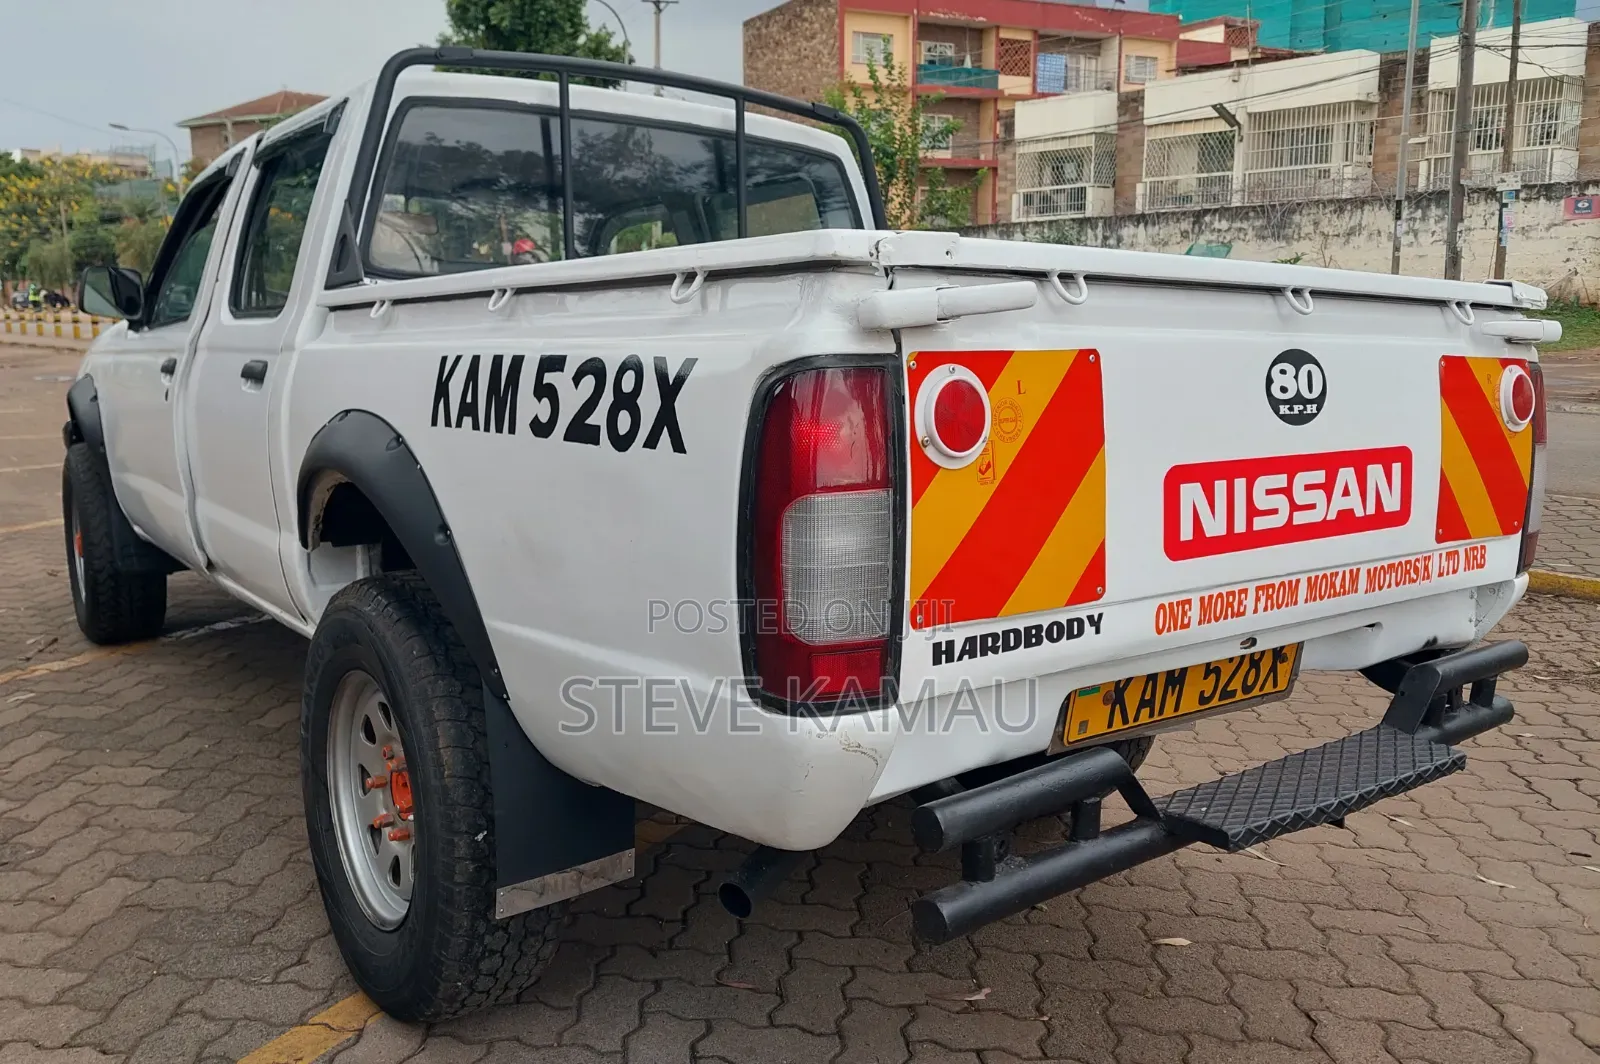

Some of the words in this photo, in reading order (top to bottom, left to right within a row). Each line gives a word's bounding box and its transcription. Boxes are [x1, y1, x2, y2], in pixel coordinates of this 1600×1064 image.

[431, 354, 526, 435] KAM
[529, 354, 699, 455] 528X
[1017, 379, 1026, 394] L
[1271, 362, 1324, 400] 80
[1278, 403, 1318, 415] K.P.H
[1179, 461, 1402, 543] NISSAN
[1154, 597, 1192, 636] ONE
[1197, 587, 1249, 626] MORE
[1252, 577, 1301, 615] FROM
[1304, 566, 1361, 604] MOKAM
[1437, 549, 1460, 578] LTD
[1463, 544, 1487, 572] NRB
[931, 612, 1104, 666] HARDBODY
[1107, 666, 1188, 729] KAM
[1198, 646, 1286, 707] 528X
